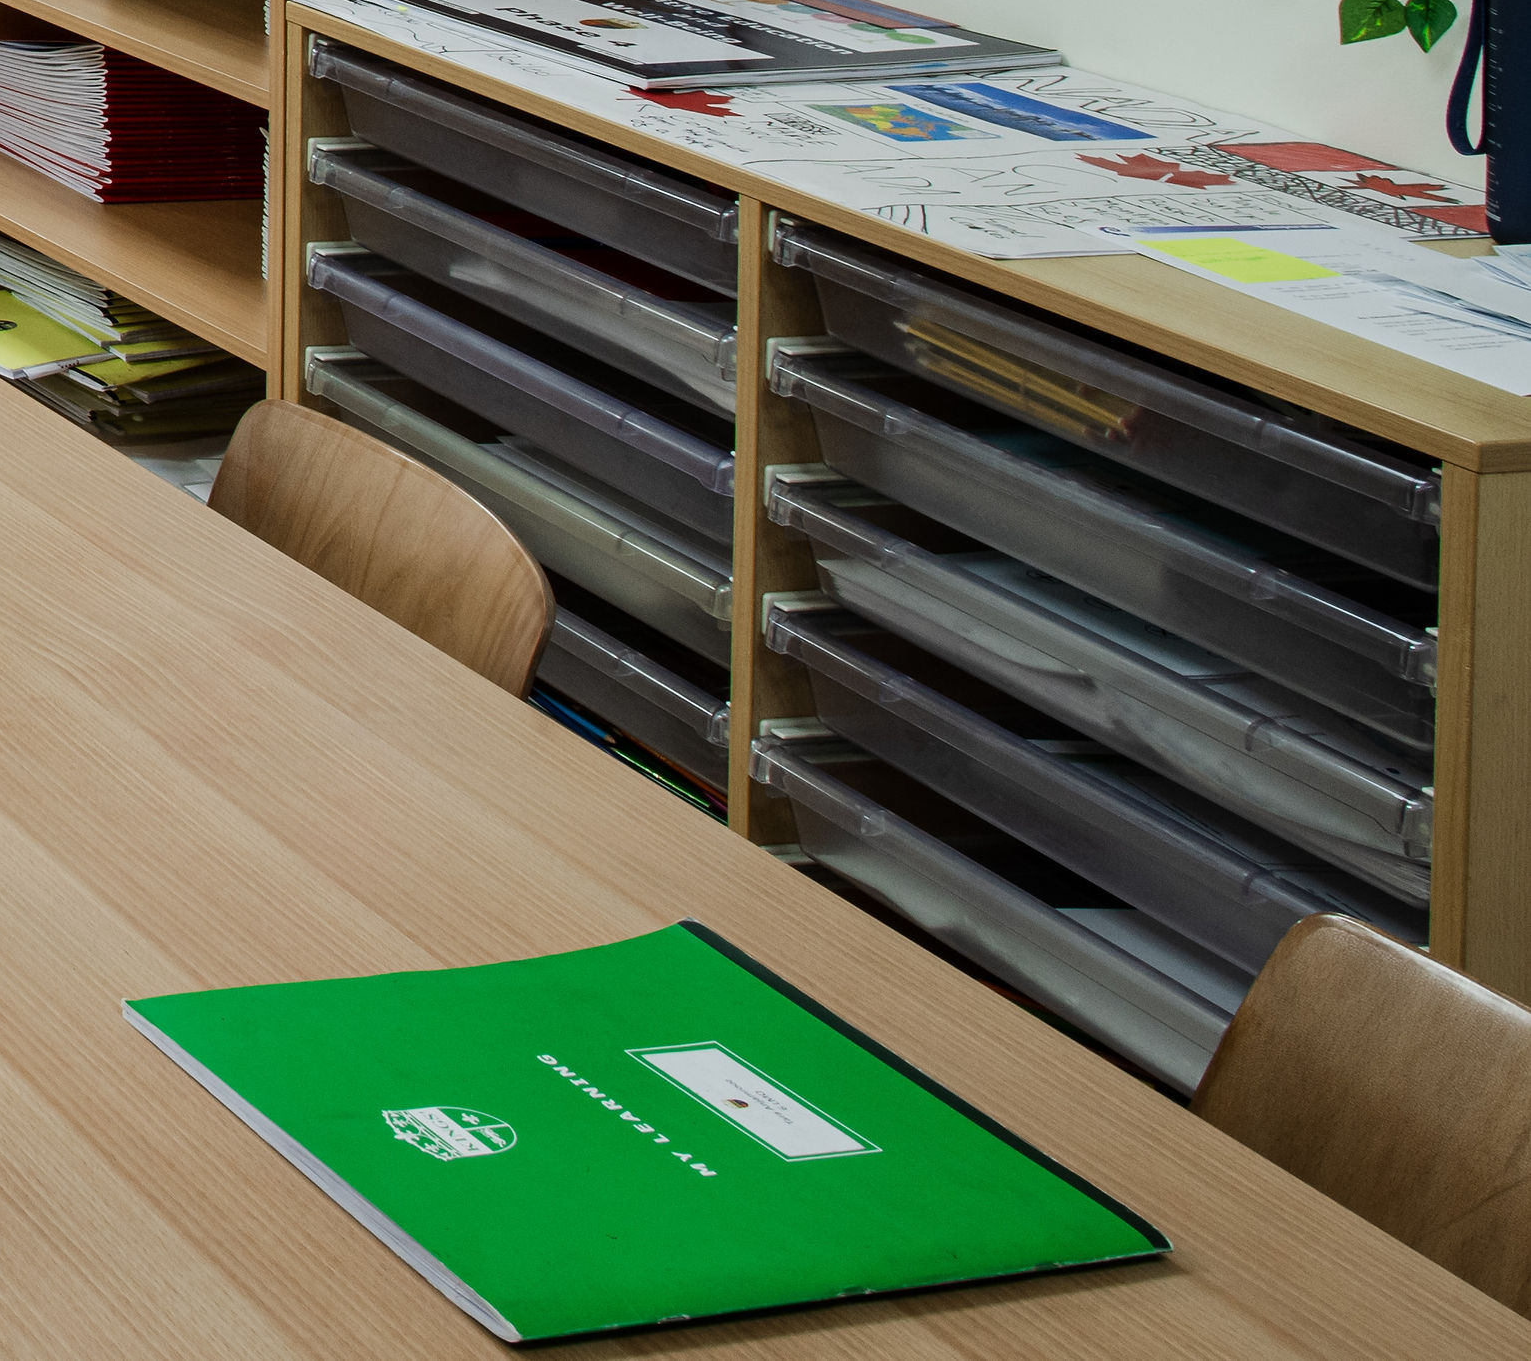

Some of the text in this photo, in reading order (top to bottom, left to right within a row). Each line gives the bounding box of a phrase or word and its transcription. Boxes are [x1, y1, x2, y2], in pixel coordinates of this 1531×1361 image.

[495, 6, 601, 39] Phase
[599, 1, 743, 45] Well-Being
[721, 15, 855, 56] Education
[536, 1053, 670, 1145] LEARNING
[671, 1151, 717, 1178] MY
